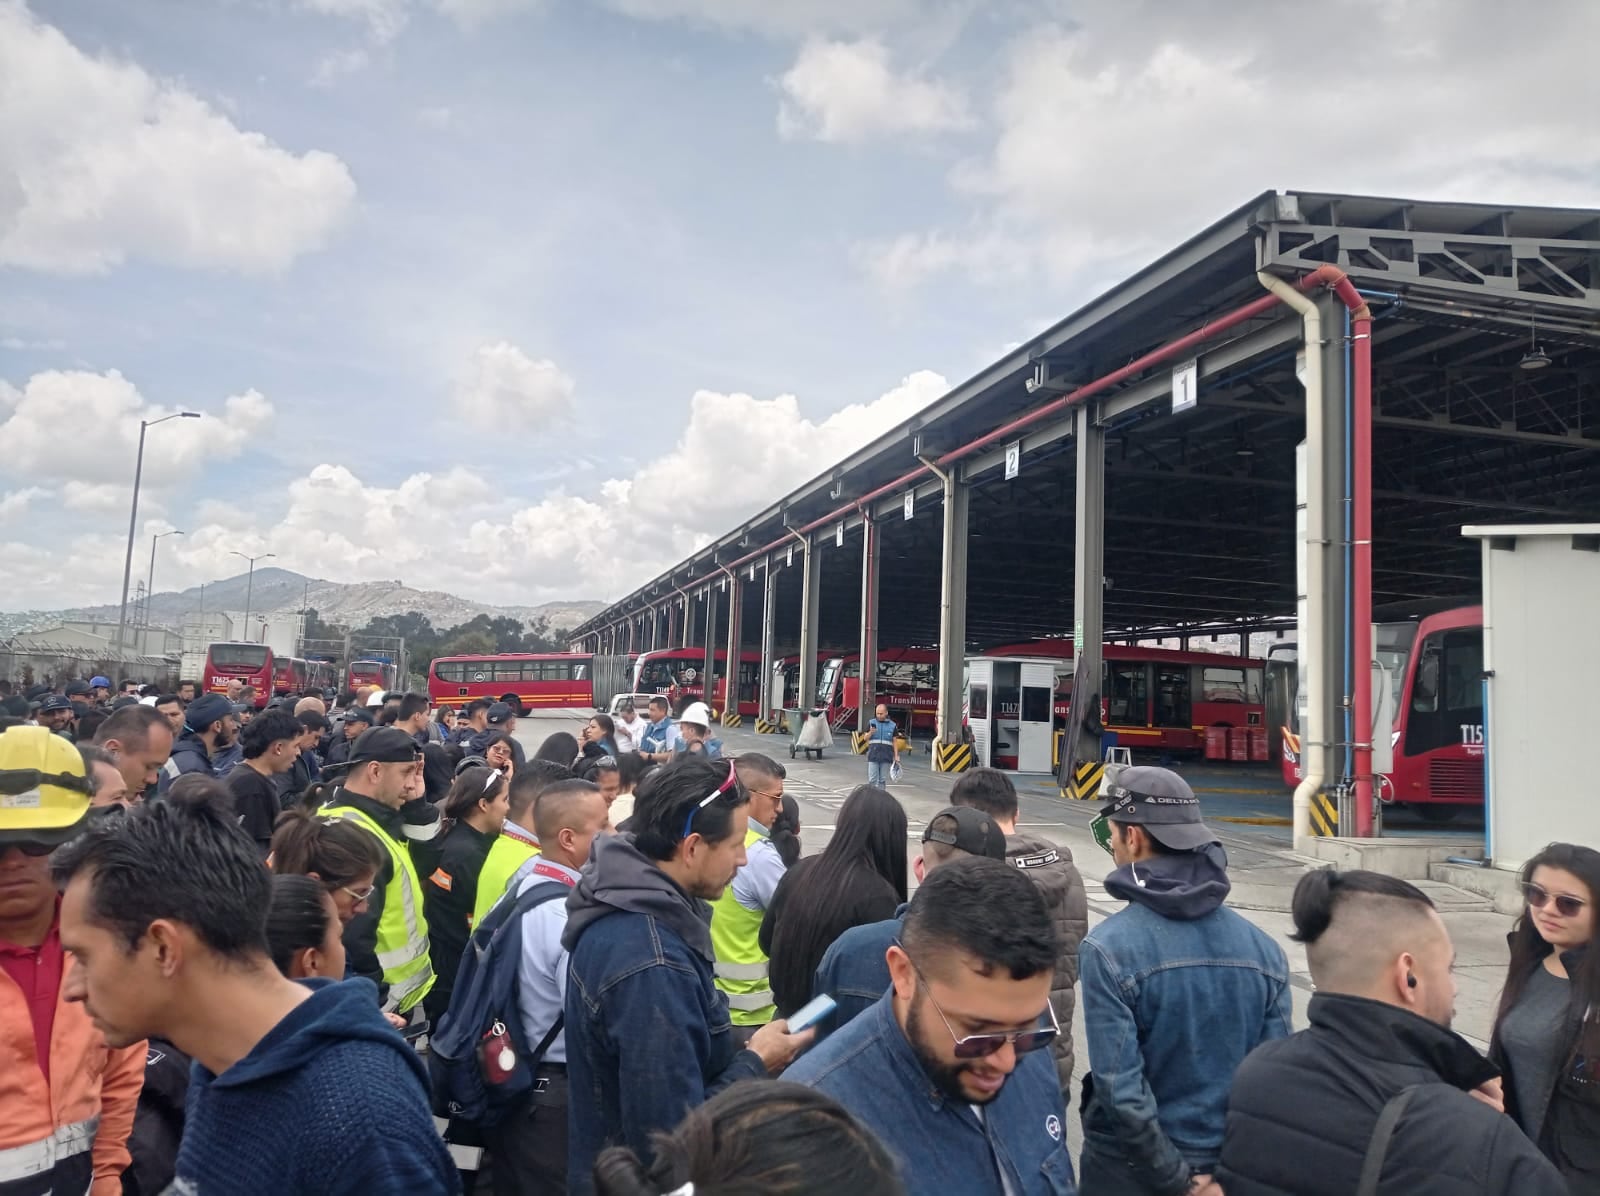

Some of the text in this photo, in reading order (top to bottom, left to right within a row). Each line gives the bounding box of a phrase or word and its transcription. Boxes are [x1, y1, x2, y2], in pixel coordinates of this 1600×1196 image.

[1181, 374, 1188, 402] 1
[1009, 451, 1016, 473] 2
[890, 695, 938, 706] TransMilenio
